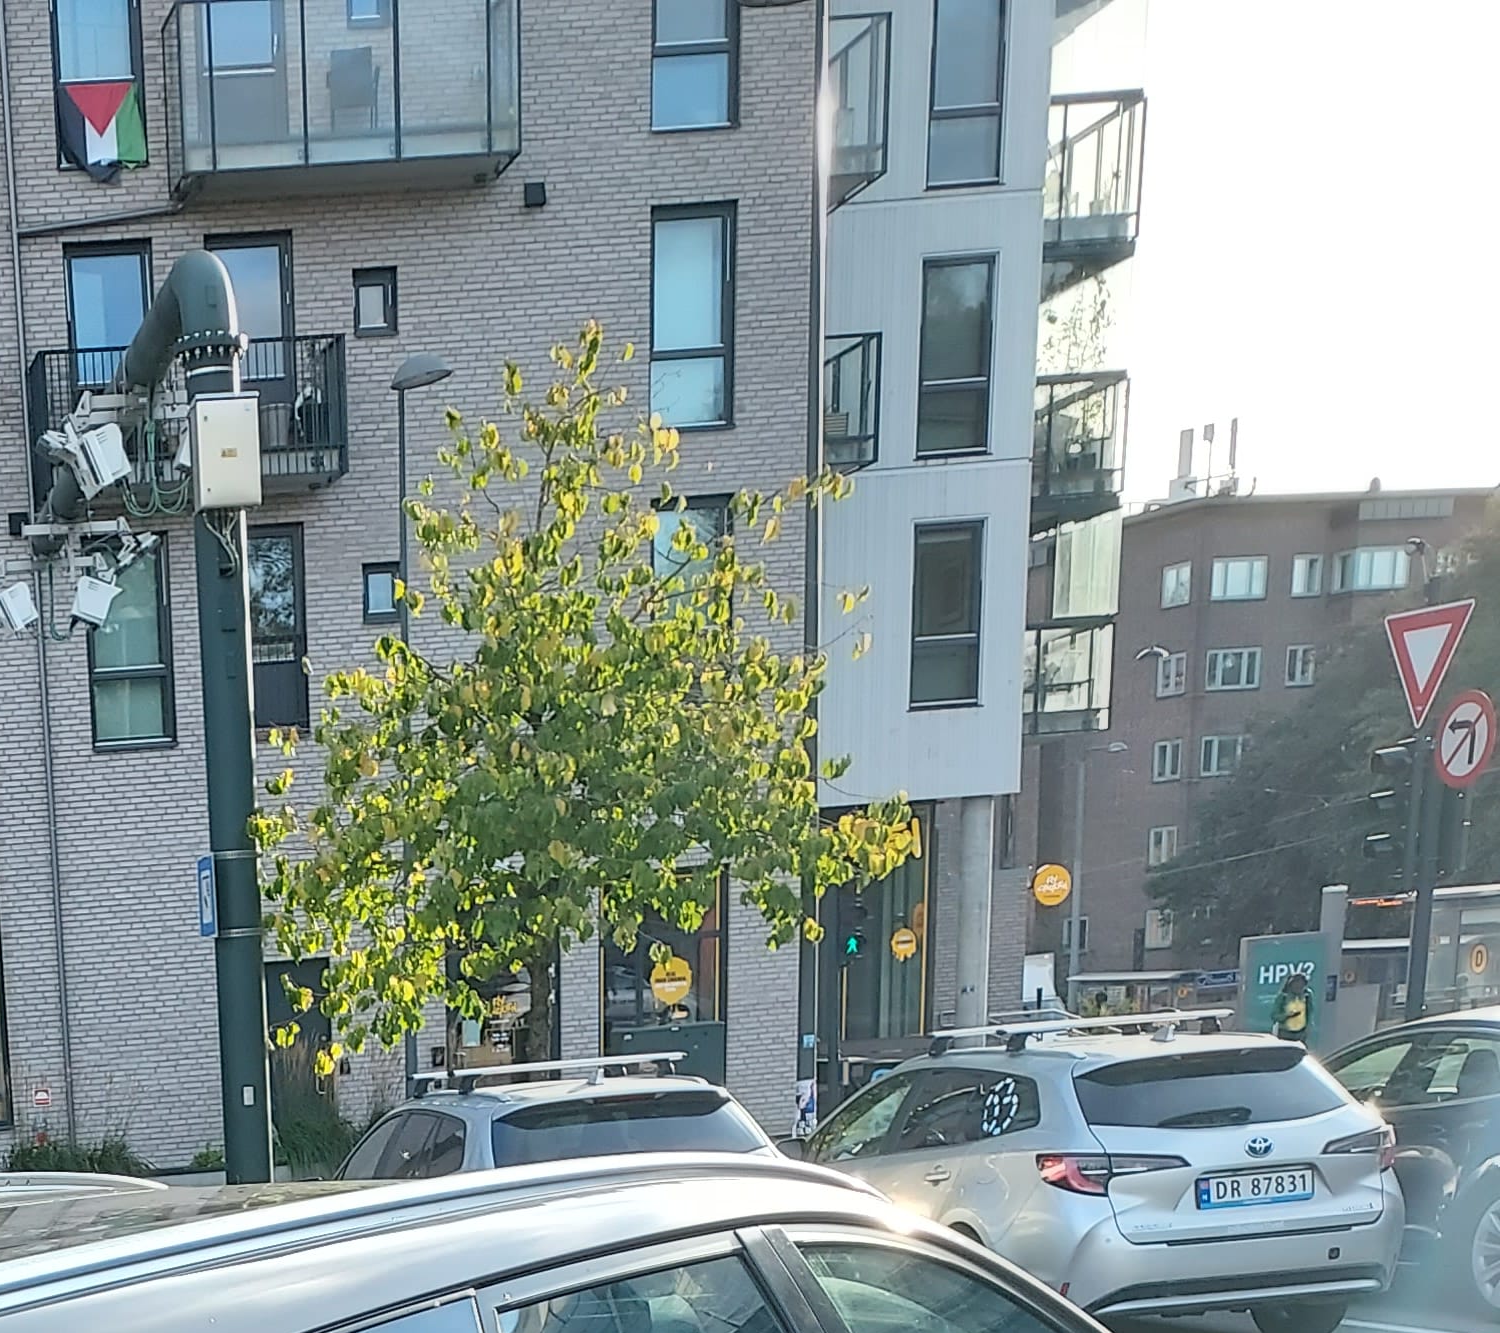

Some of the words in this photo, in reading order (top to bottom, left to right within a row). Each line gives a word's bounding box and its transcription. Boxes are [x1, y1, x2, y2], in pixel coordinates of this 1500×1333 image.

[1259, 962, 1315, 984] HPV?
[1216, 1180, 1241, 1199] DR
[1251, 1174, 1306, 1196] 87831
